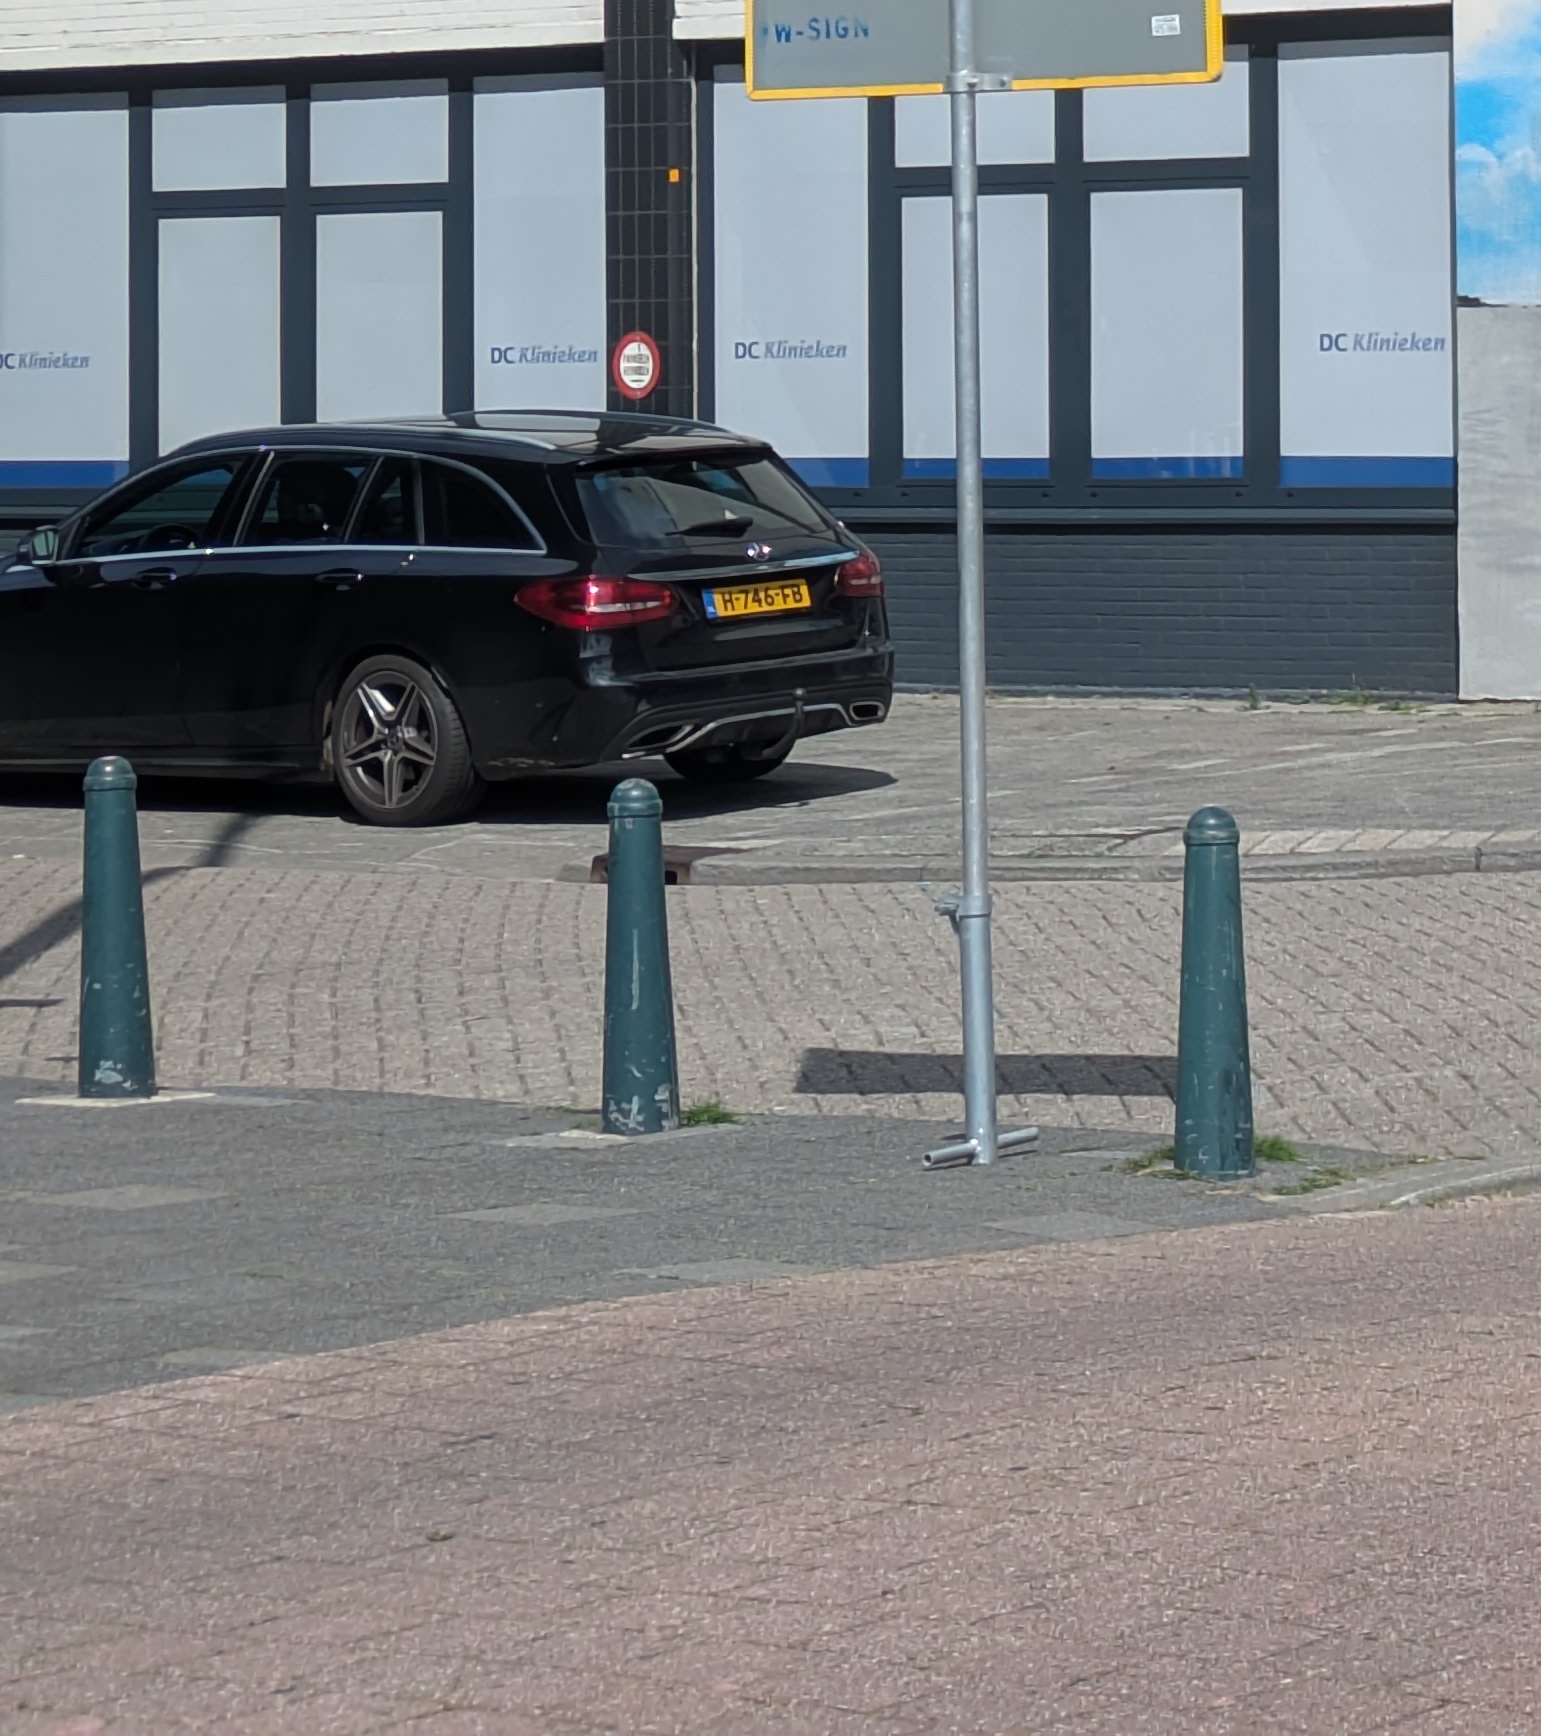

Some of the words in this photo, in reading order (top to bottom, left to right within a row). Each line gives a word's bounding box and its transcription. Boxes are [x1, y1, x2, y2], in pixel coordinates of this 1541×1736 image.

[735, 341, 760, 360] DC
[764, 339, 848, 359] Klinieken
[1319, 332, 1348, 353] DC
[1352, 331, 1446, 352] Klinieken
[490, 346, 516, 364] DC
[518, 344, 599, 364] Klinieken
[720, 583, 804, 612] H-746-FB
